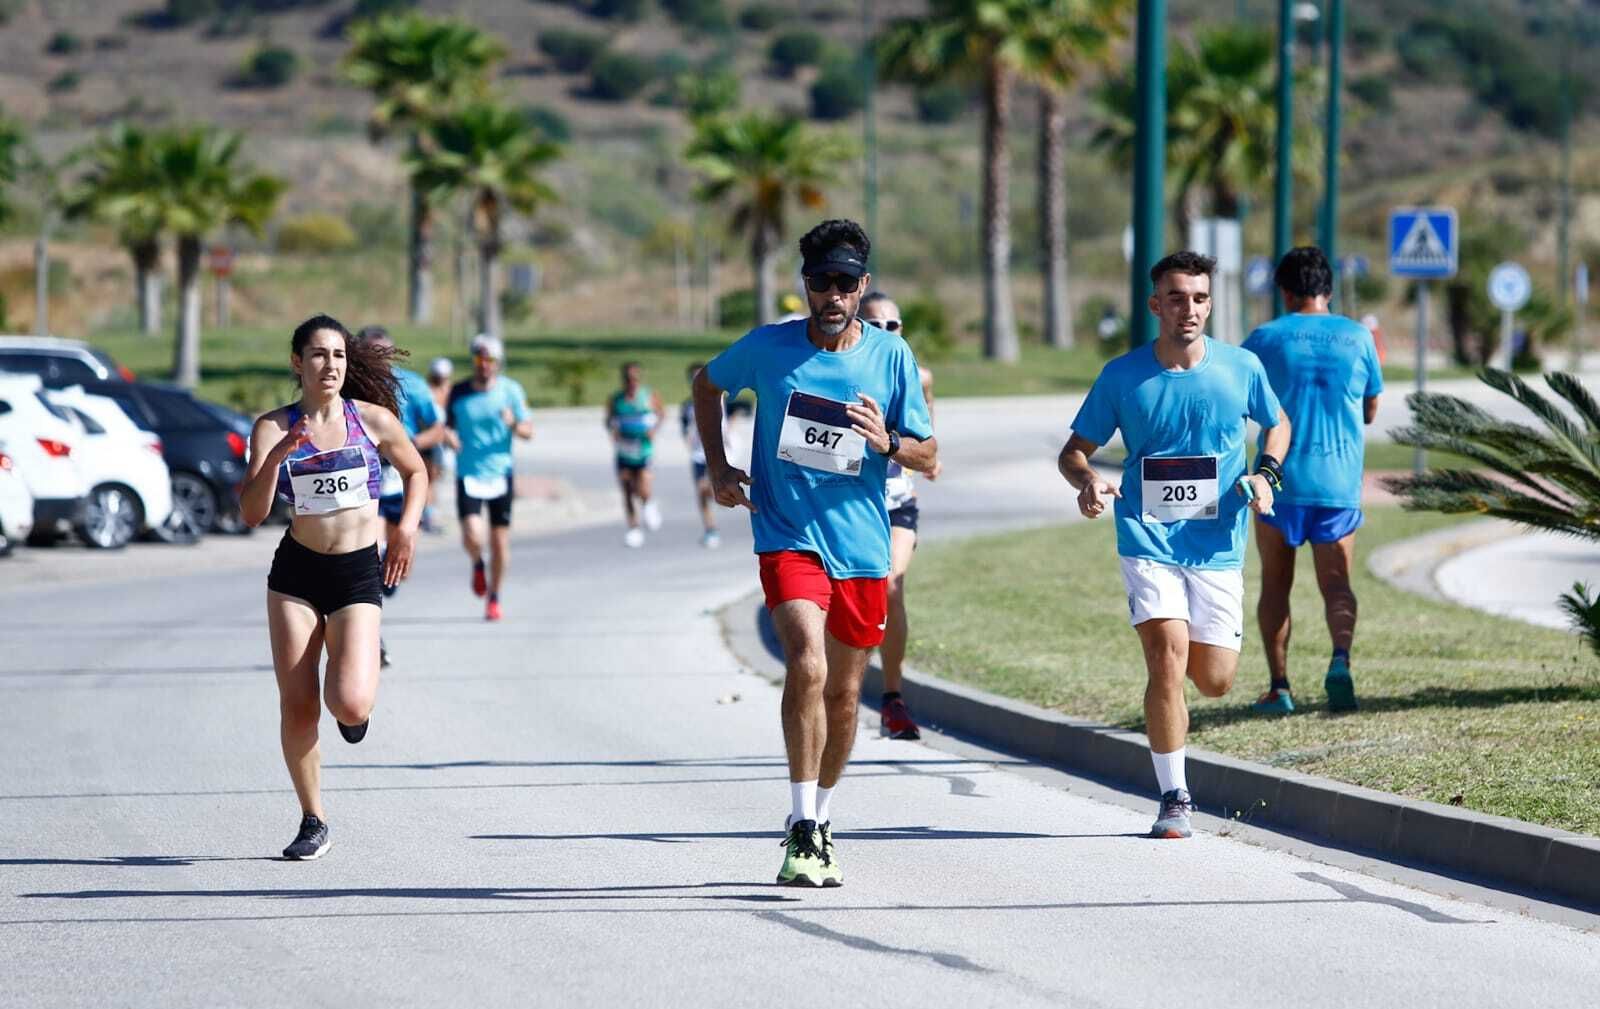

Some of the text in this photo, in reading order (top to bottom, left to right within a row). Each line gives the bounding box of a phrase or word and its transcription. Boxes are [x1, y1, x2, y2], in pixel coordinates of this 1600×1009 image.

[1280, 330, 1338, 345] ARRERA
[805, 427, 843, 449] 647
[313, 476, 349, 495] 236
[1163, 485, 1197, 502] 203
